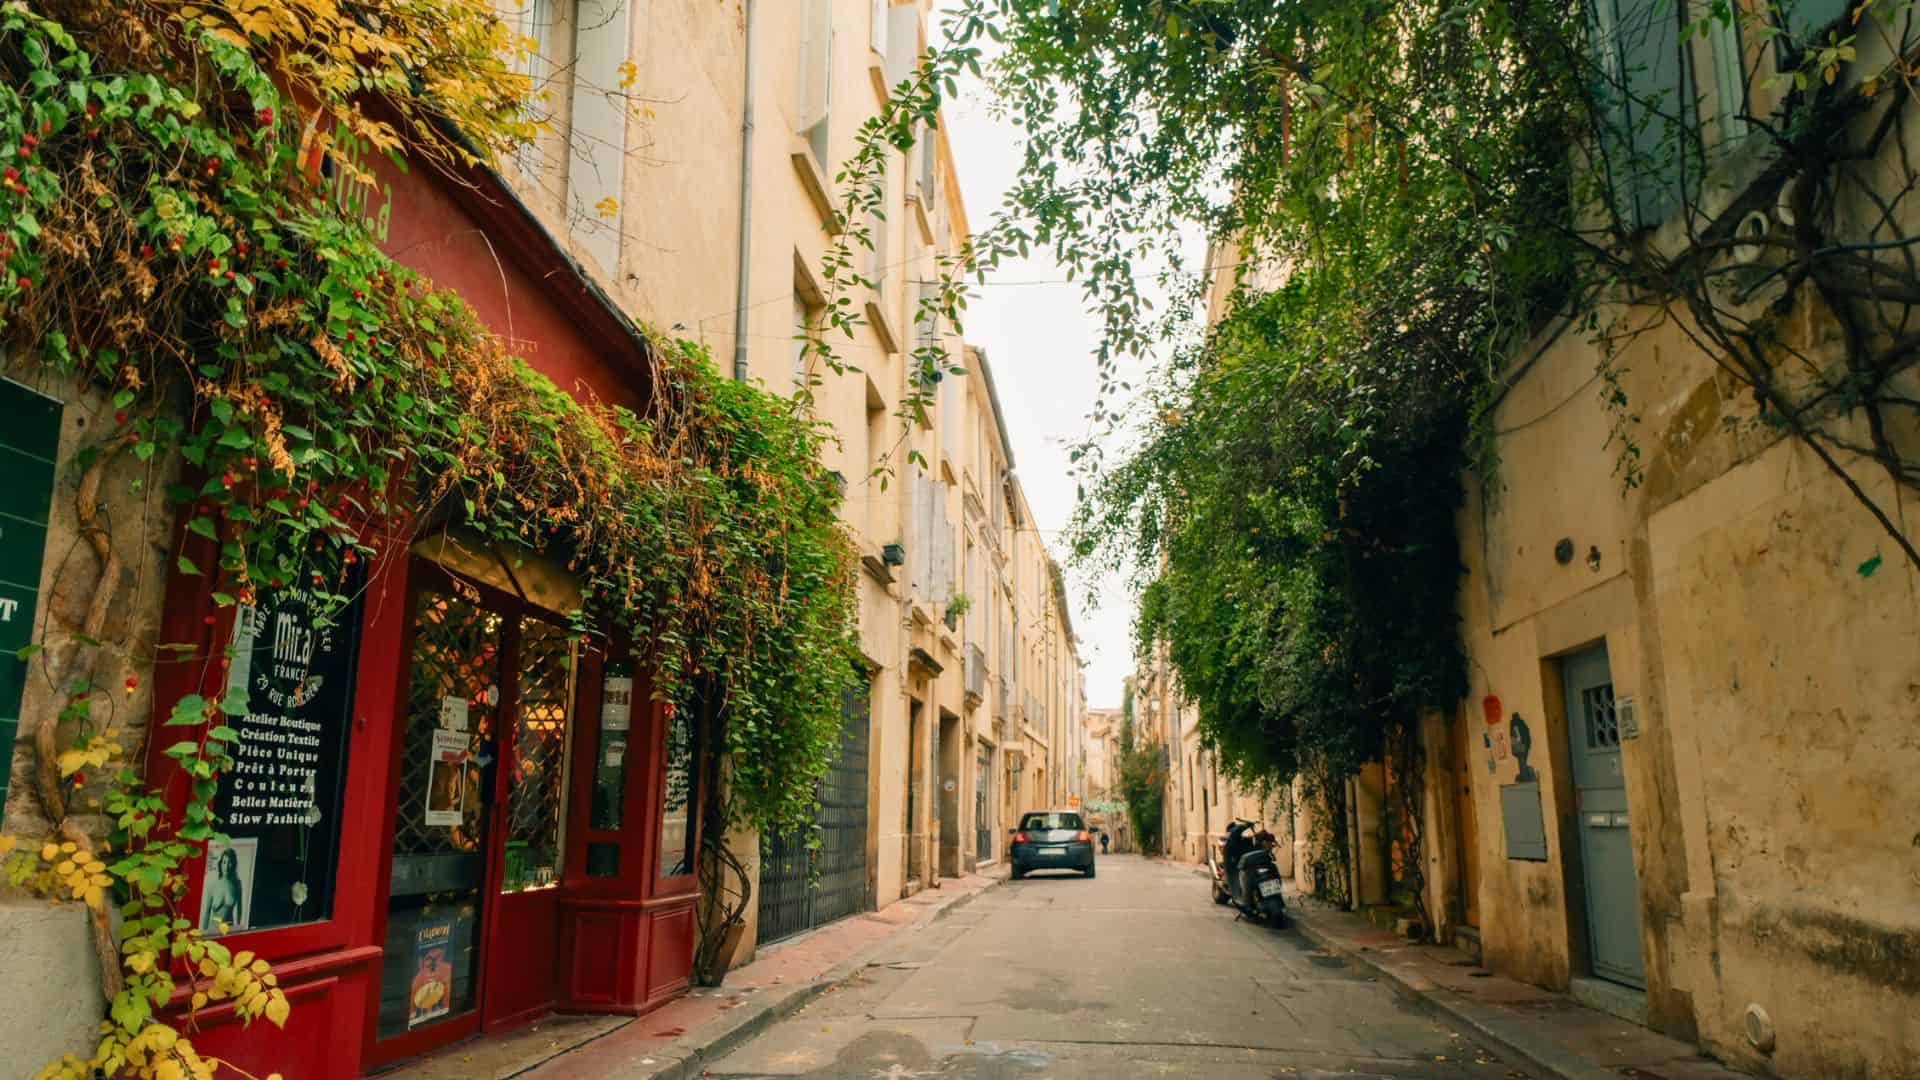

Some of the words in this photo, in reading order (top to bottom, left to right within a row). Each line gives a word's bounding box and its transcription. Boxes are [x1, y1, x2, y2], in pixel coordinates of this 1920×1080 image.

[0, 597, 18, 622] T
[252, 602, 272, 638] MADE
[274, 664, 306, 682] FRANCE
[256, 673, 269, 691] 29
[267, 687, 285, 706] RUE
[242, 712, 278, 726] Atelier
[279, 715, 322, 732] Boutique
[240, 728, 286, 744] Création
[287, 733, 320, 747] Textile
[238, 744, 273, 758] Pièce
[277, 747, 319, 763] Unique
[236, 761, 264, 774] Prêt
[268, 763, 275, 775] à
[279, 764, 317, 777] Porter
[231, 795, 267, 808] Belles
[268, 796, 313, 809] Matières
[229, 812, 263, 825] Slow
[266, 812, 313, 825] Fashion
